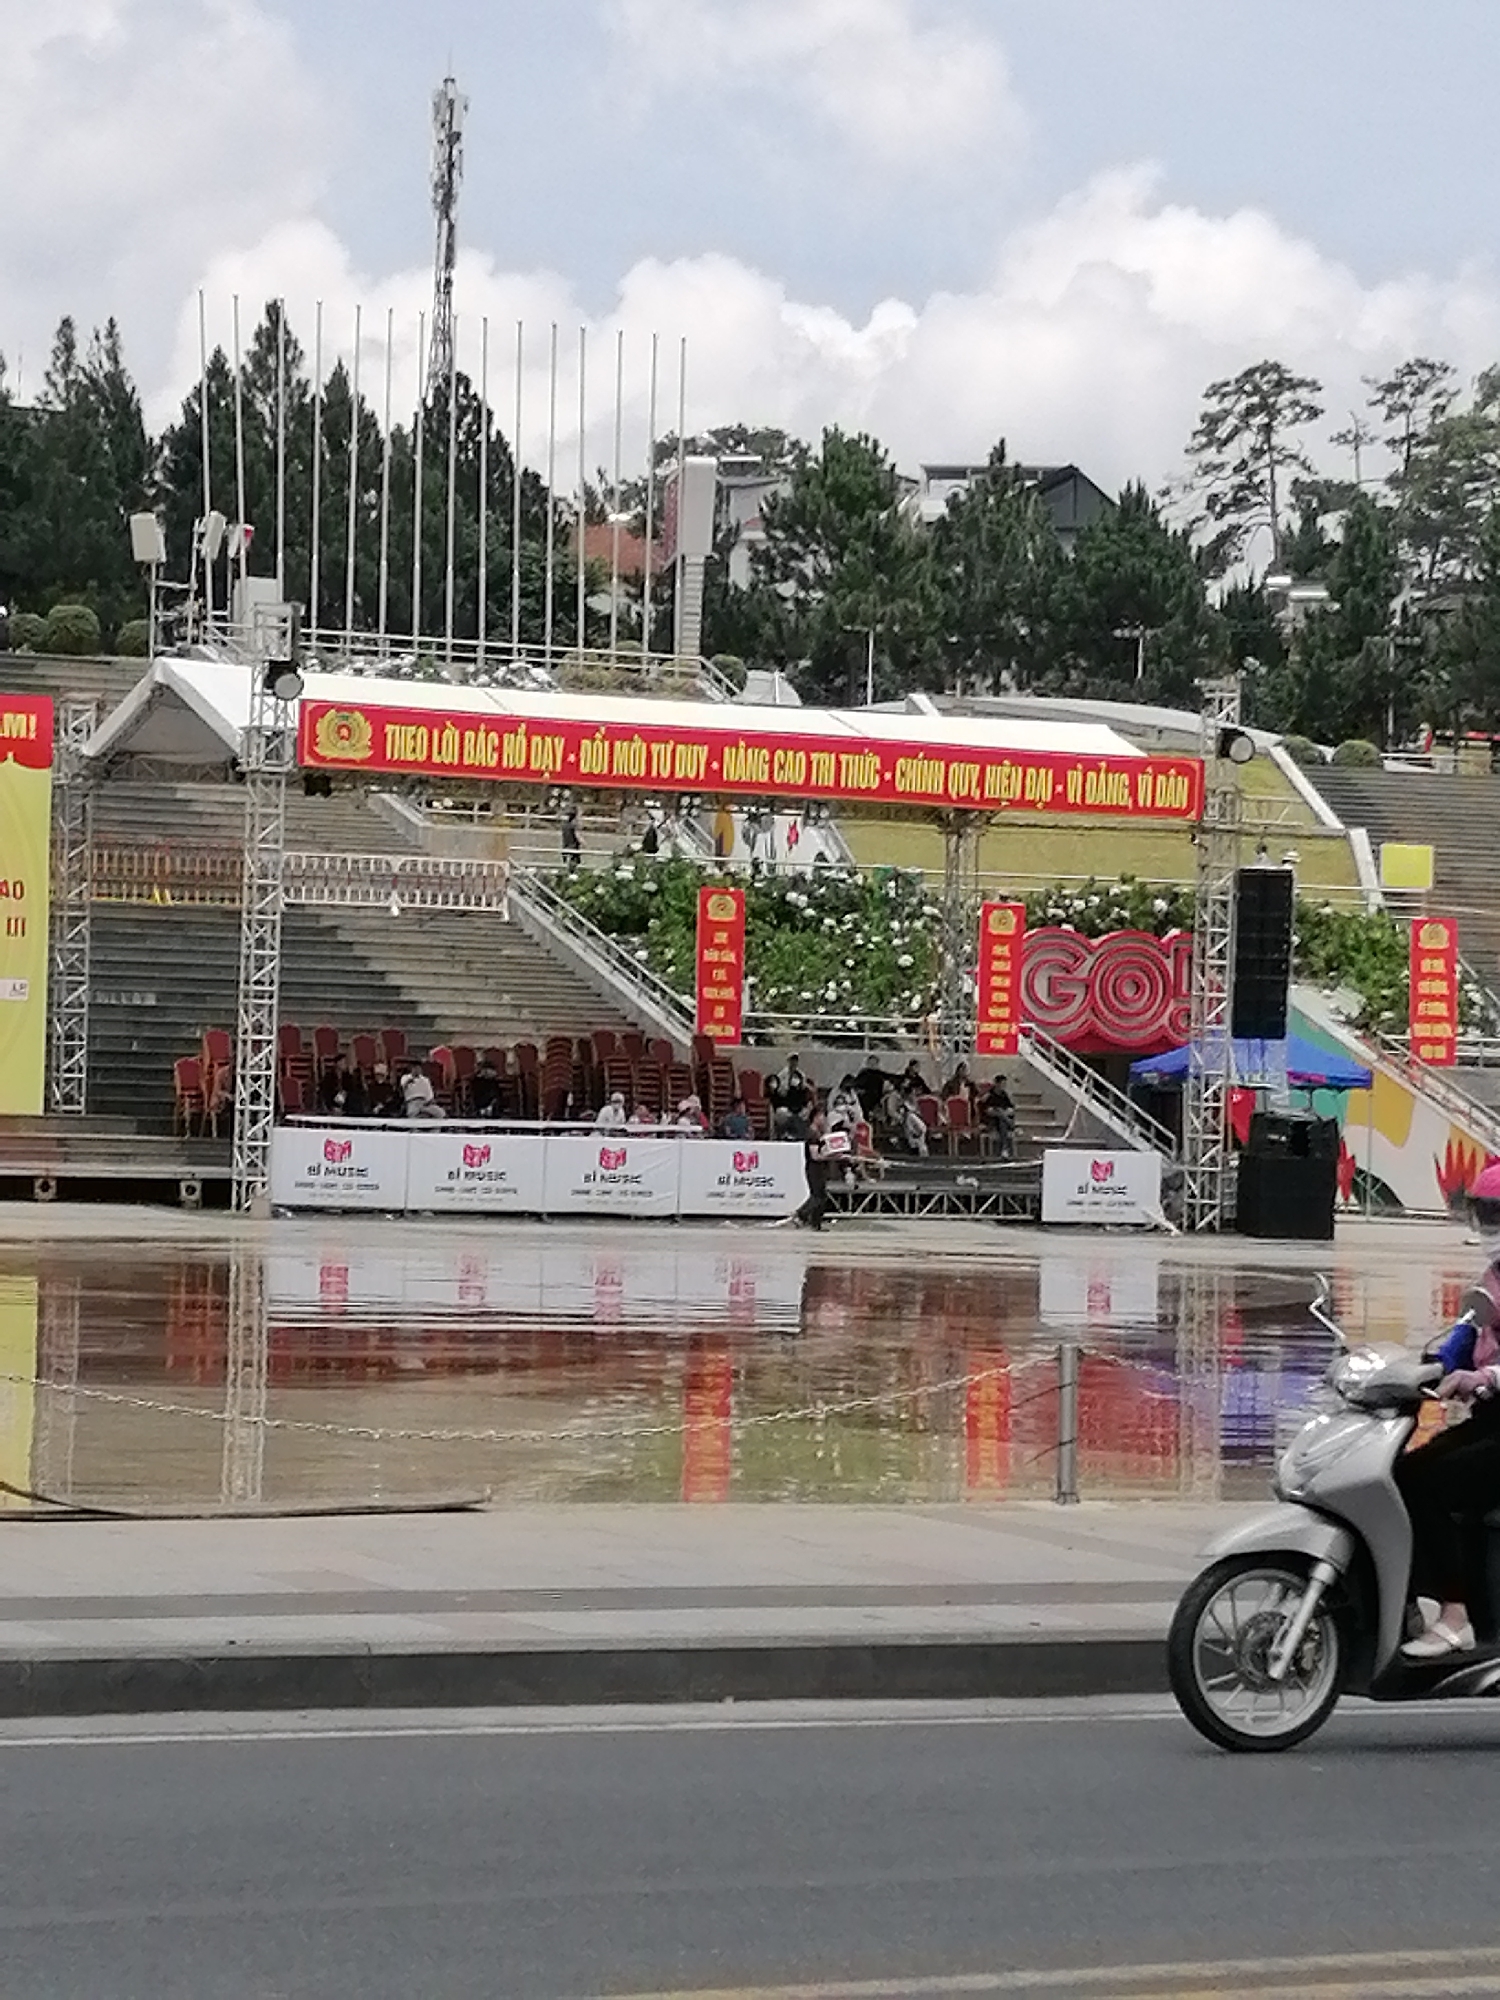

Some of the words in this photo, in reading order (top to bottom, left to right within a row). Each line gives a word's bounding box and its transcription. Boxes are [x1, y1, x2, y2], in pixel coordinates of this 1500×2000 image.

[0, 713, 37, 740] M!
[384, 723, 428, 761] THEO
[432, 720, 459, 766] LỜI
[463, 722, 499, 767] BÁC
[530, 735, 565, 779] DẠY
[579, 726, 609, 775] ĐỔI
[612, 733, 647, 777] MỚI
[651, 739, 674, 778] TƯ
[675, 744, 708, 780] DUY
[723, 738, 770, 783] NÂNG
[773, 749, 806, 785] CAO
[810, 752, 836, 787] TRI
[839, 748, 881, 789] THỨC
[895, 751, 945, 794] CHÍNH
[948, 762, 980, 800] QUY,
[984, 759, 1023, 806] HIỆN
[1067, 762, 1083, 805] VÌ
[1085, 761, 1133, 810] ĐẢNG,
[1138, 765, 1153, 808] VÌ
[1154, 768, 1189, 810] DÂN
